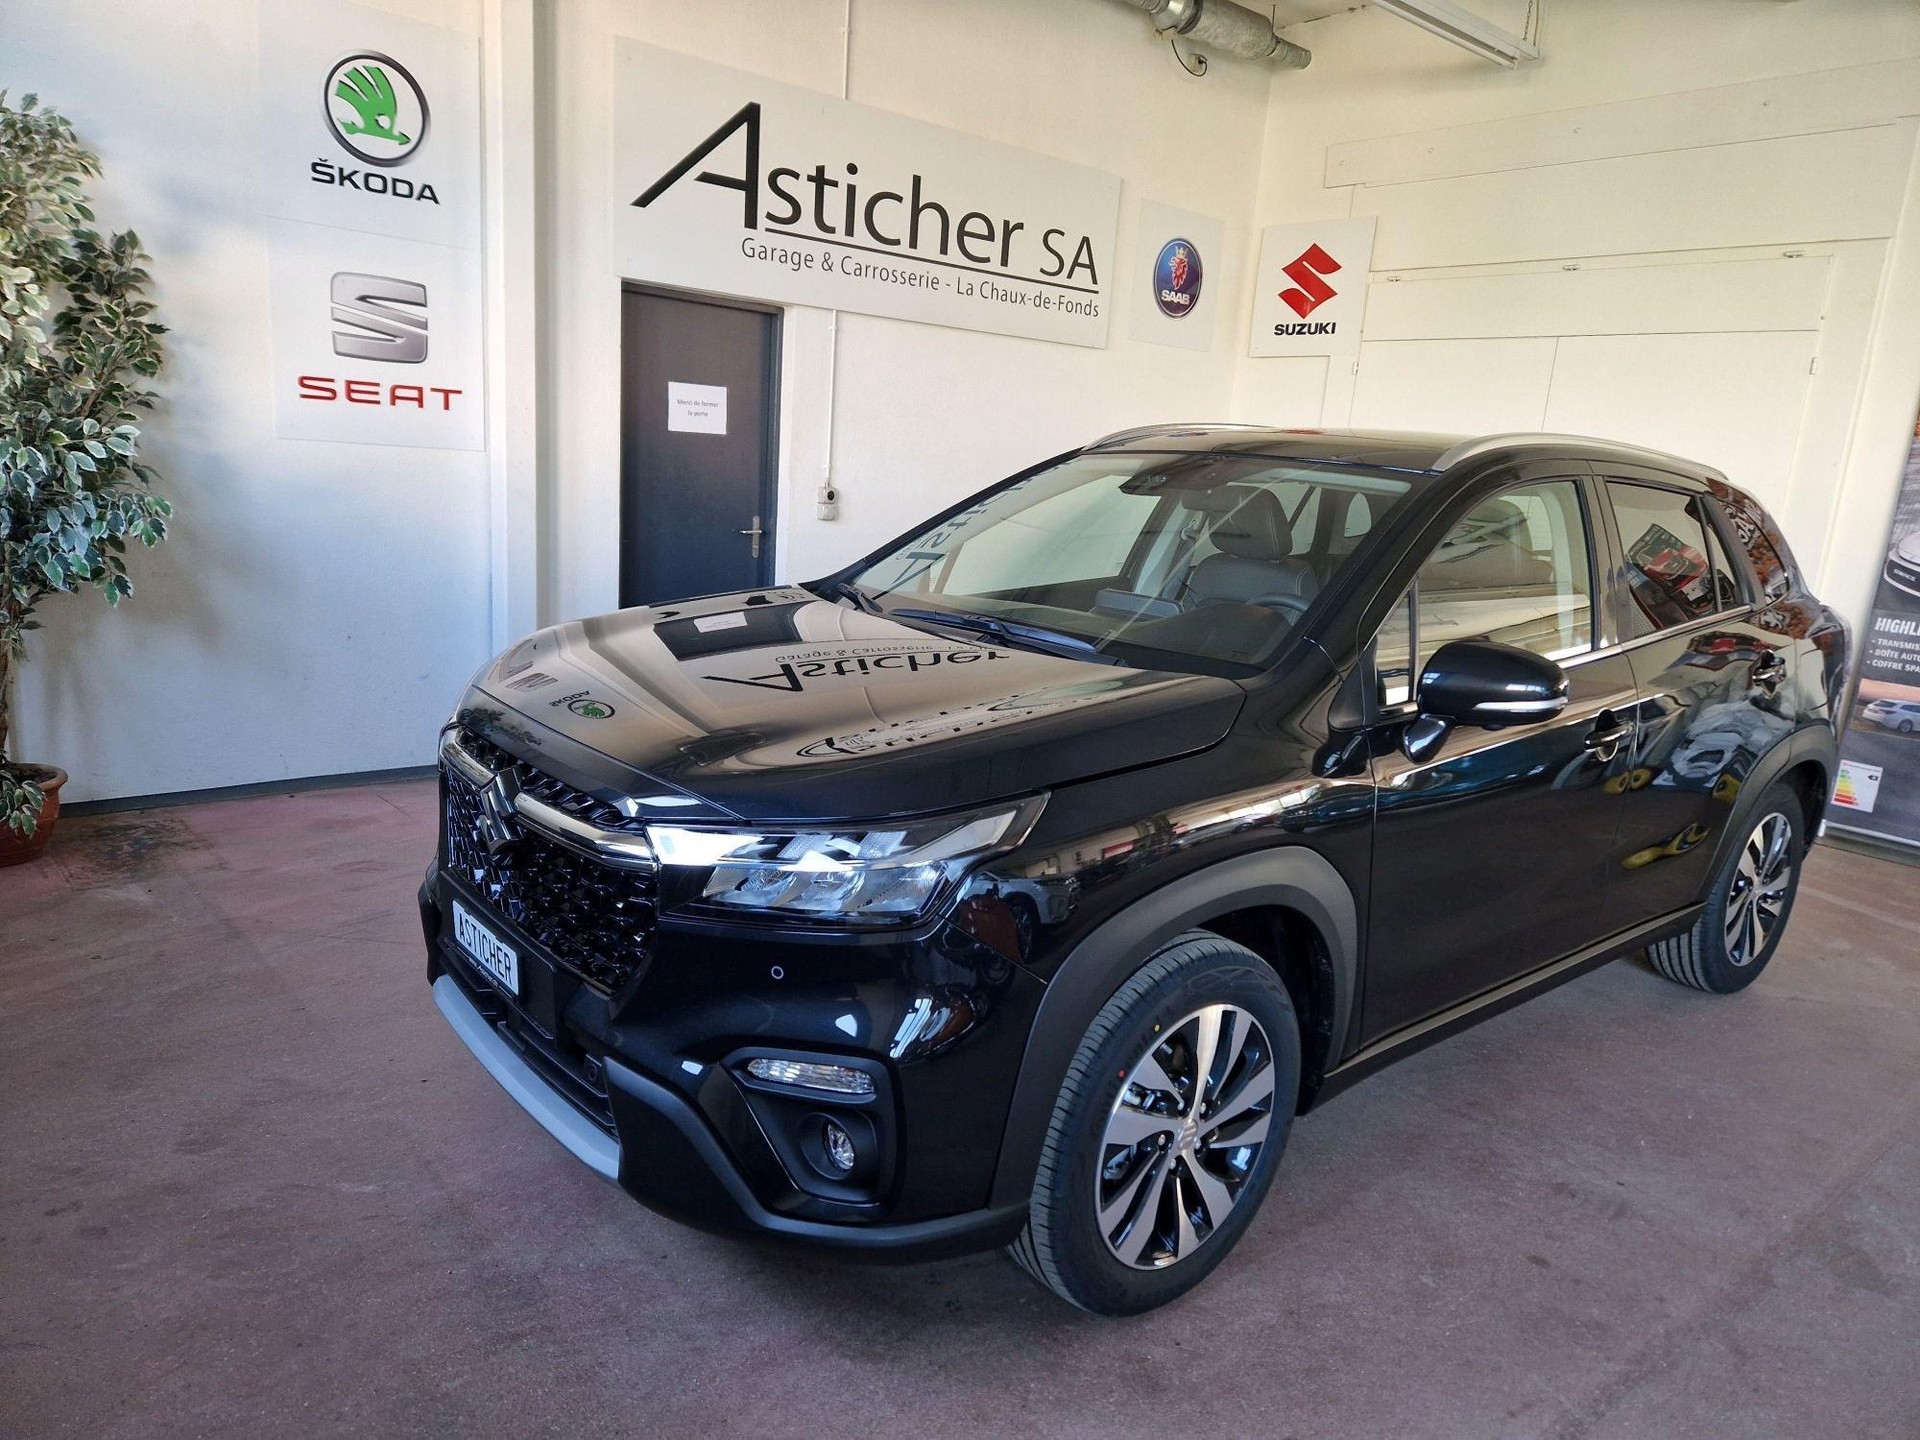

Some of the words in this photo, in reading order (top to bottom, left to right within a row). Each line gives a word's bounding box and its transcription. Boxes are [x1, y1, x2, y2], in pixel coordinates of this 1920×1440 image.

[311, 157, 440, 205] ŠKODA
[630, 101, 1024, 268] Asticher
[1039, 228, 1099, 286] SA
[741, 237, 815, 272] Garage
[821, 251, 835, 273] &
[840, 255, 940, 290] Carrosserie
[957, 276, 974, 296] La
[979, 280, 1100, 318] Chaux-de-Fonds
[1161, 289, 1191, 305] SAAB
[1273, 321, 1337, 336] SUZUKI
[297, 375, 463, 411] SEAT
[459, 912, 513, 987] ASTICHER
